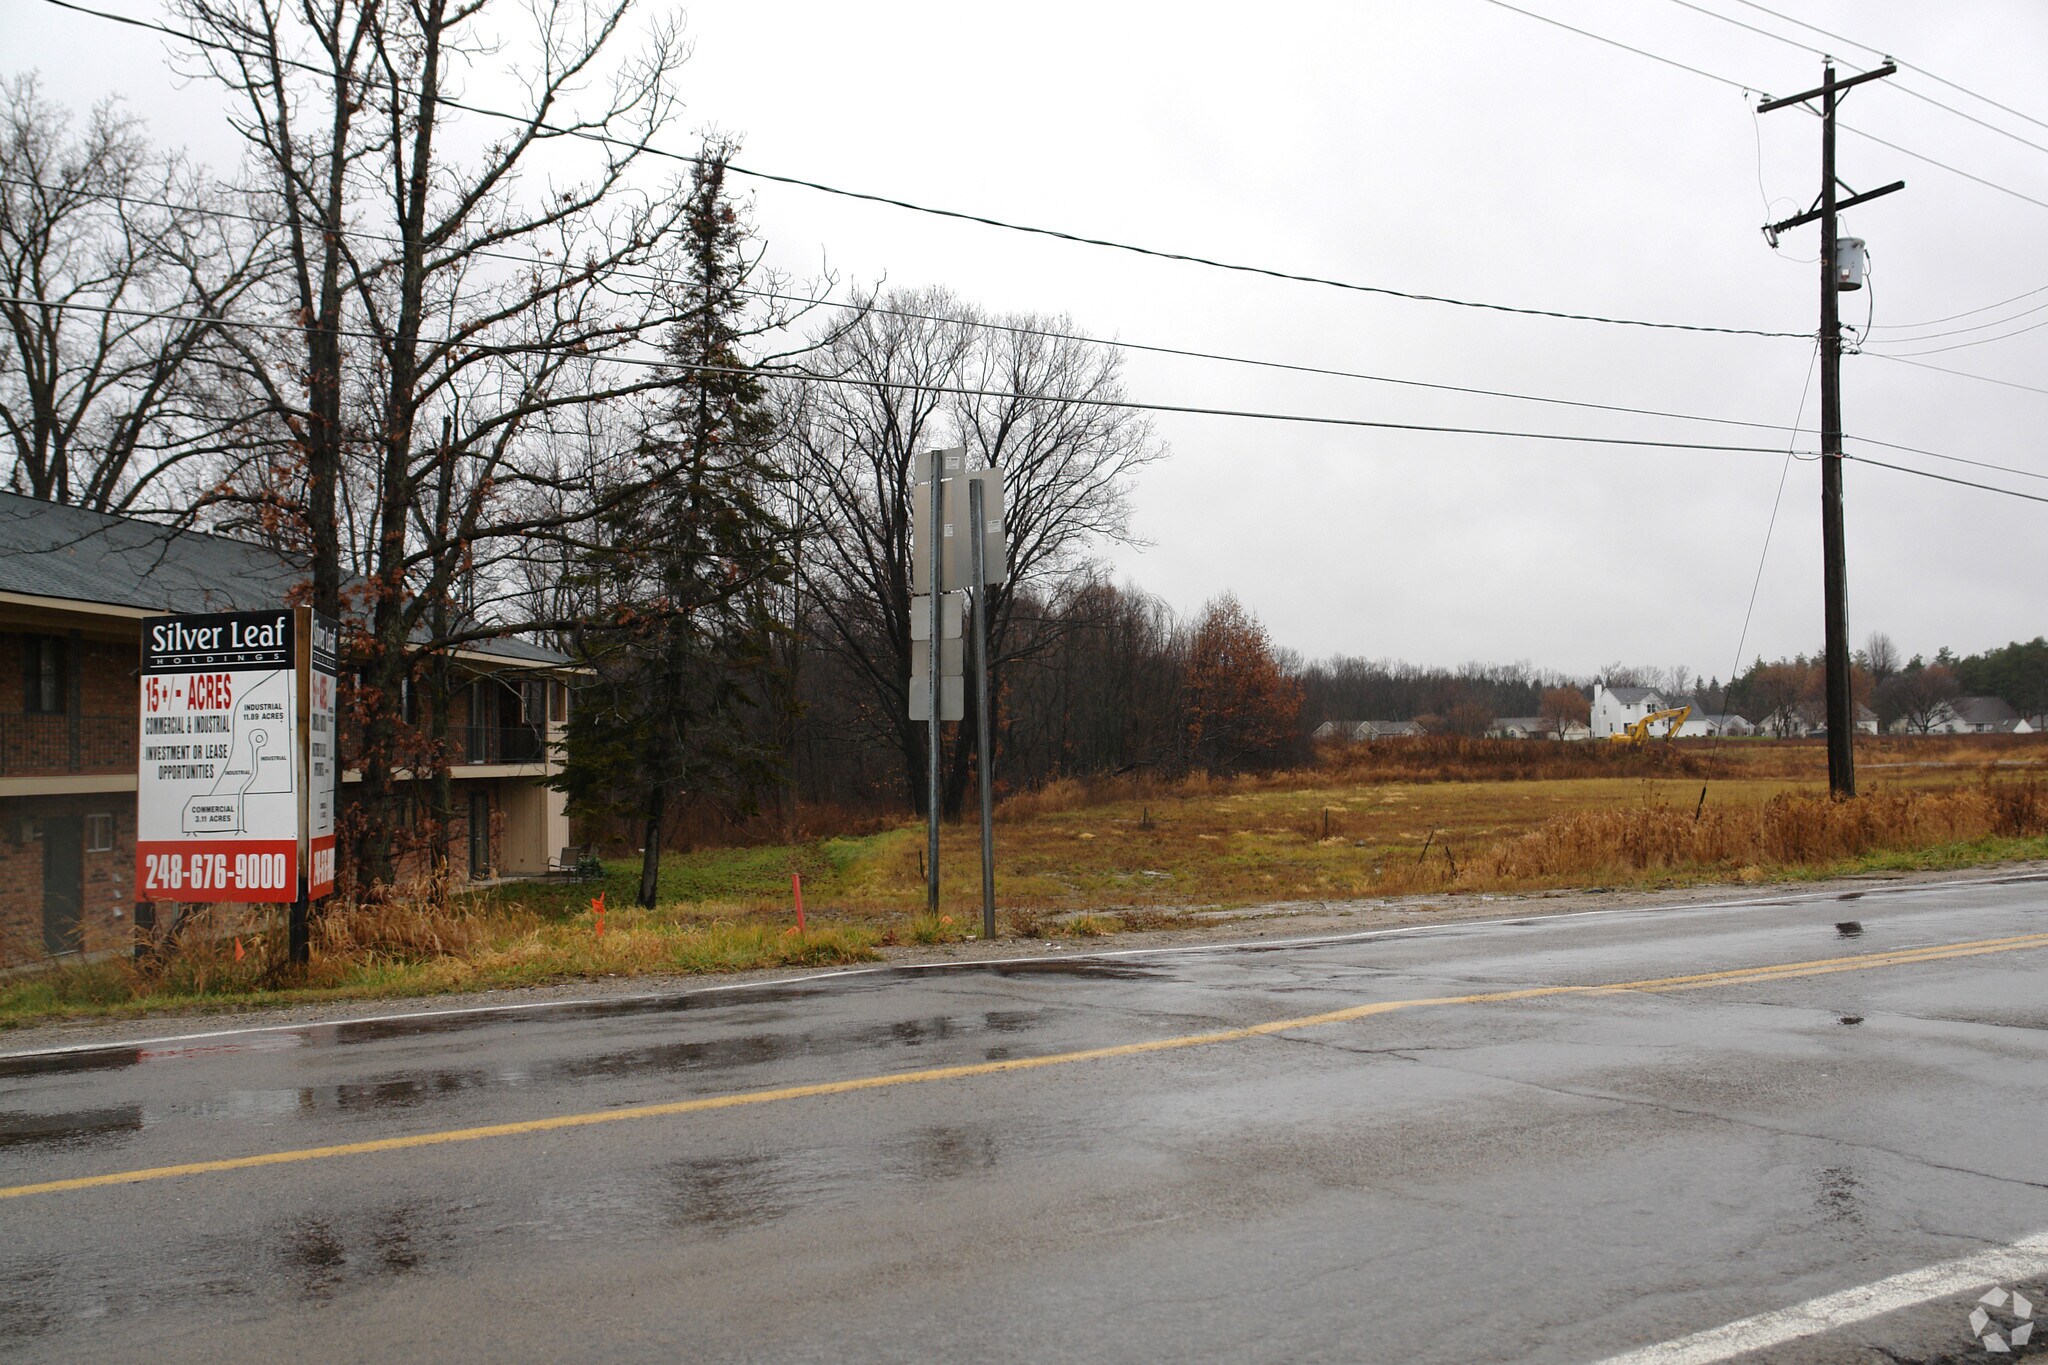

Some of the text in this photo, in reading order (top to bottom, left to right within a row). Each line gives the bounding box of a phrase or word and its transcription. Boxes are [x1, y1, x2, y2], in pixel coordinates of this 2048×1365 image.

[151, 616, 286, 652] Silver Leaf
[156, 652, 280, 665] HOLDINGS
[187, 674, 232, 710] ACRES
[243, 703, 283, 711] INDUSTRIAL
[145, 715, 230, 735] COMMERCIAL & INDUSTRIAL
[145, 744, 228, 760] INVESTMENT OR LEASE
[158, 764, 214, 779] OPPORTUNITIES
[191, 805, 235, 813] COMMERCIAL
[145, 853, 286, 889] 248-676-9000
